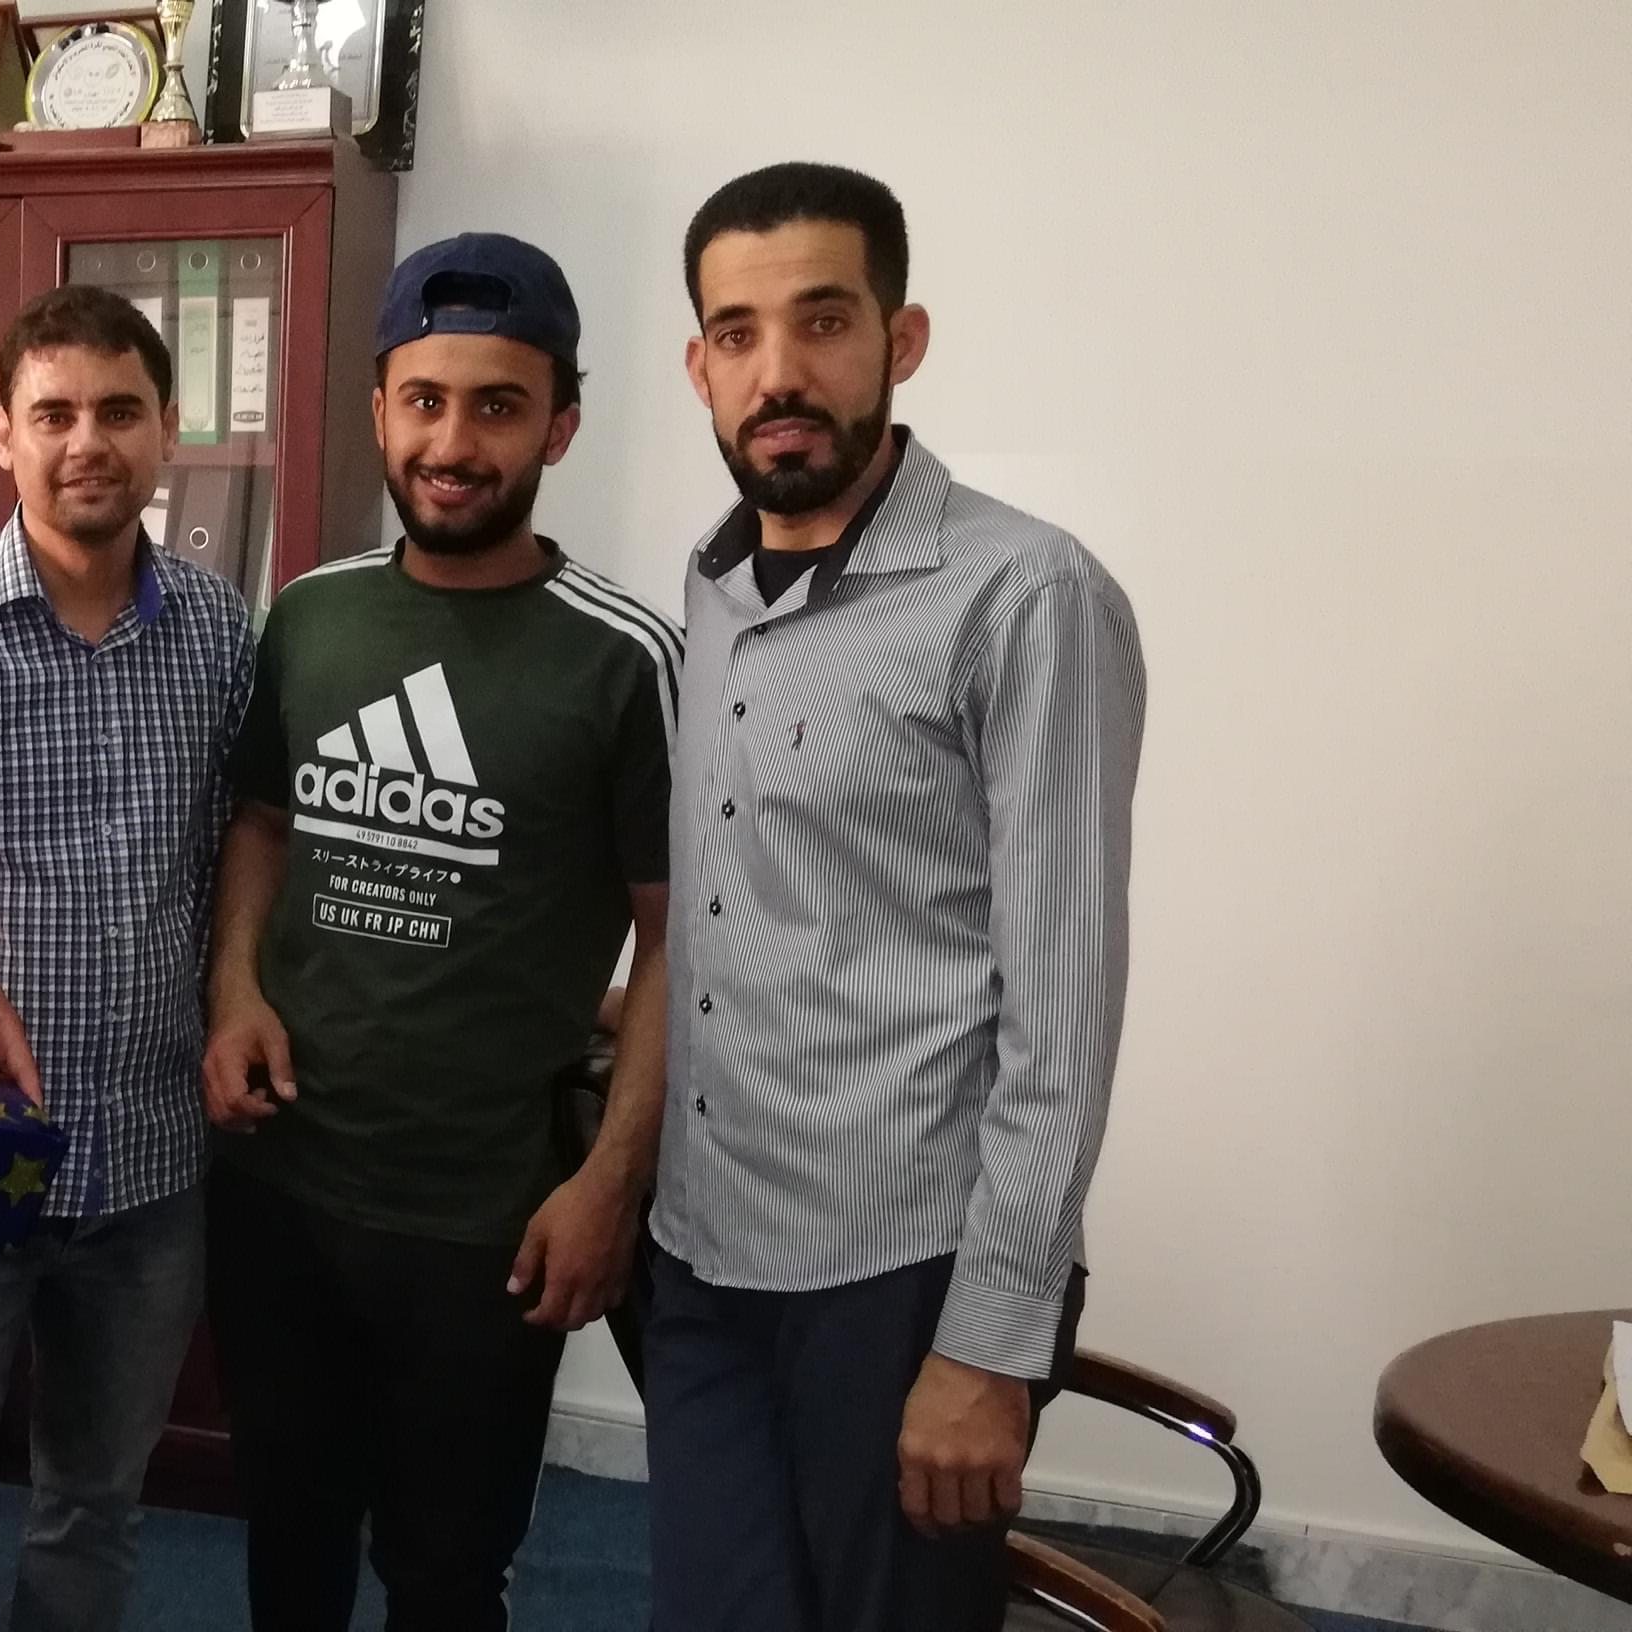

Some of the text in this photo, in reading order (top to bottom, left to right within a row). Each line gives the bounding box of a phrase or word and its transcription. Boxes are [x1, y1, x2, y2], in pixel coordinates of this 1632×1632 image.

[294, 761, 506, 839] adidas
[329, 874, 437, 907] FOR CREATORS ONLY
[319, 902, 440, 940] US UK FR JP CHN
